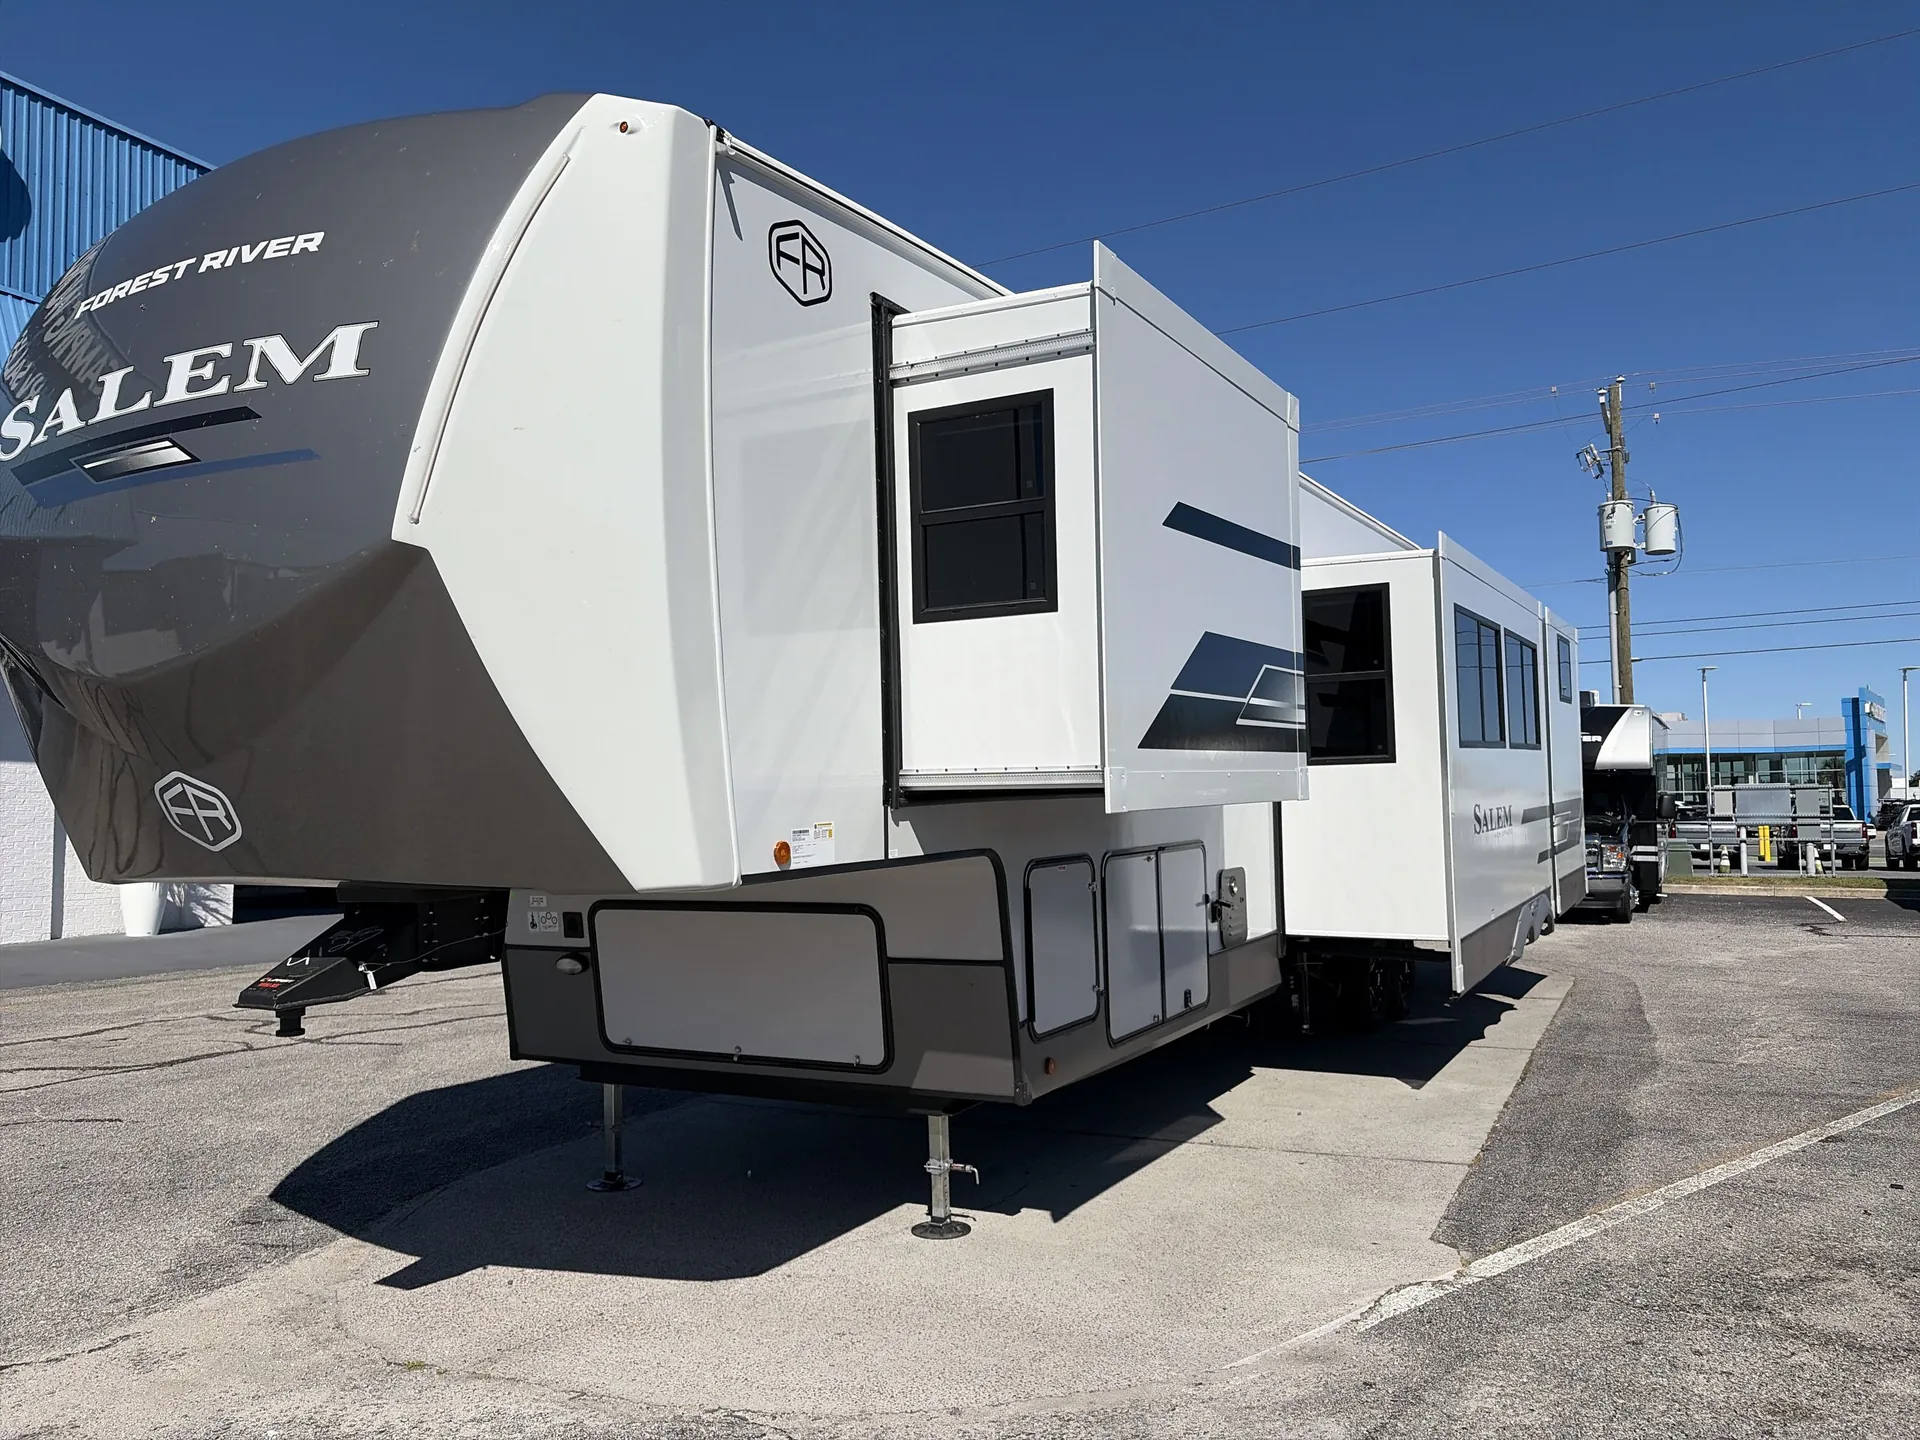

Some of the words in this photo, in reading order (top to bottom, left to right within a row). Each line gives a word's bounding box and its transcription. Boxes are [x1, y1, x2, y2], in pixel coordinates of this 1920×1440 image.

[75, 256, 196, 319] FOREST
[198, 231, 325, 273] RIVER
[0, 321, 379, 462] SALEM
[1473, 803, 1513, 834] SALEM
